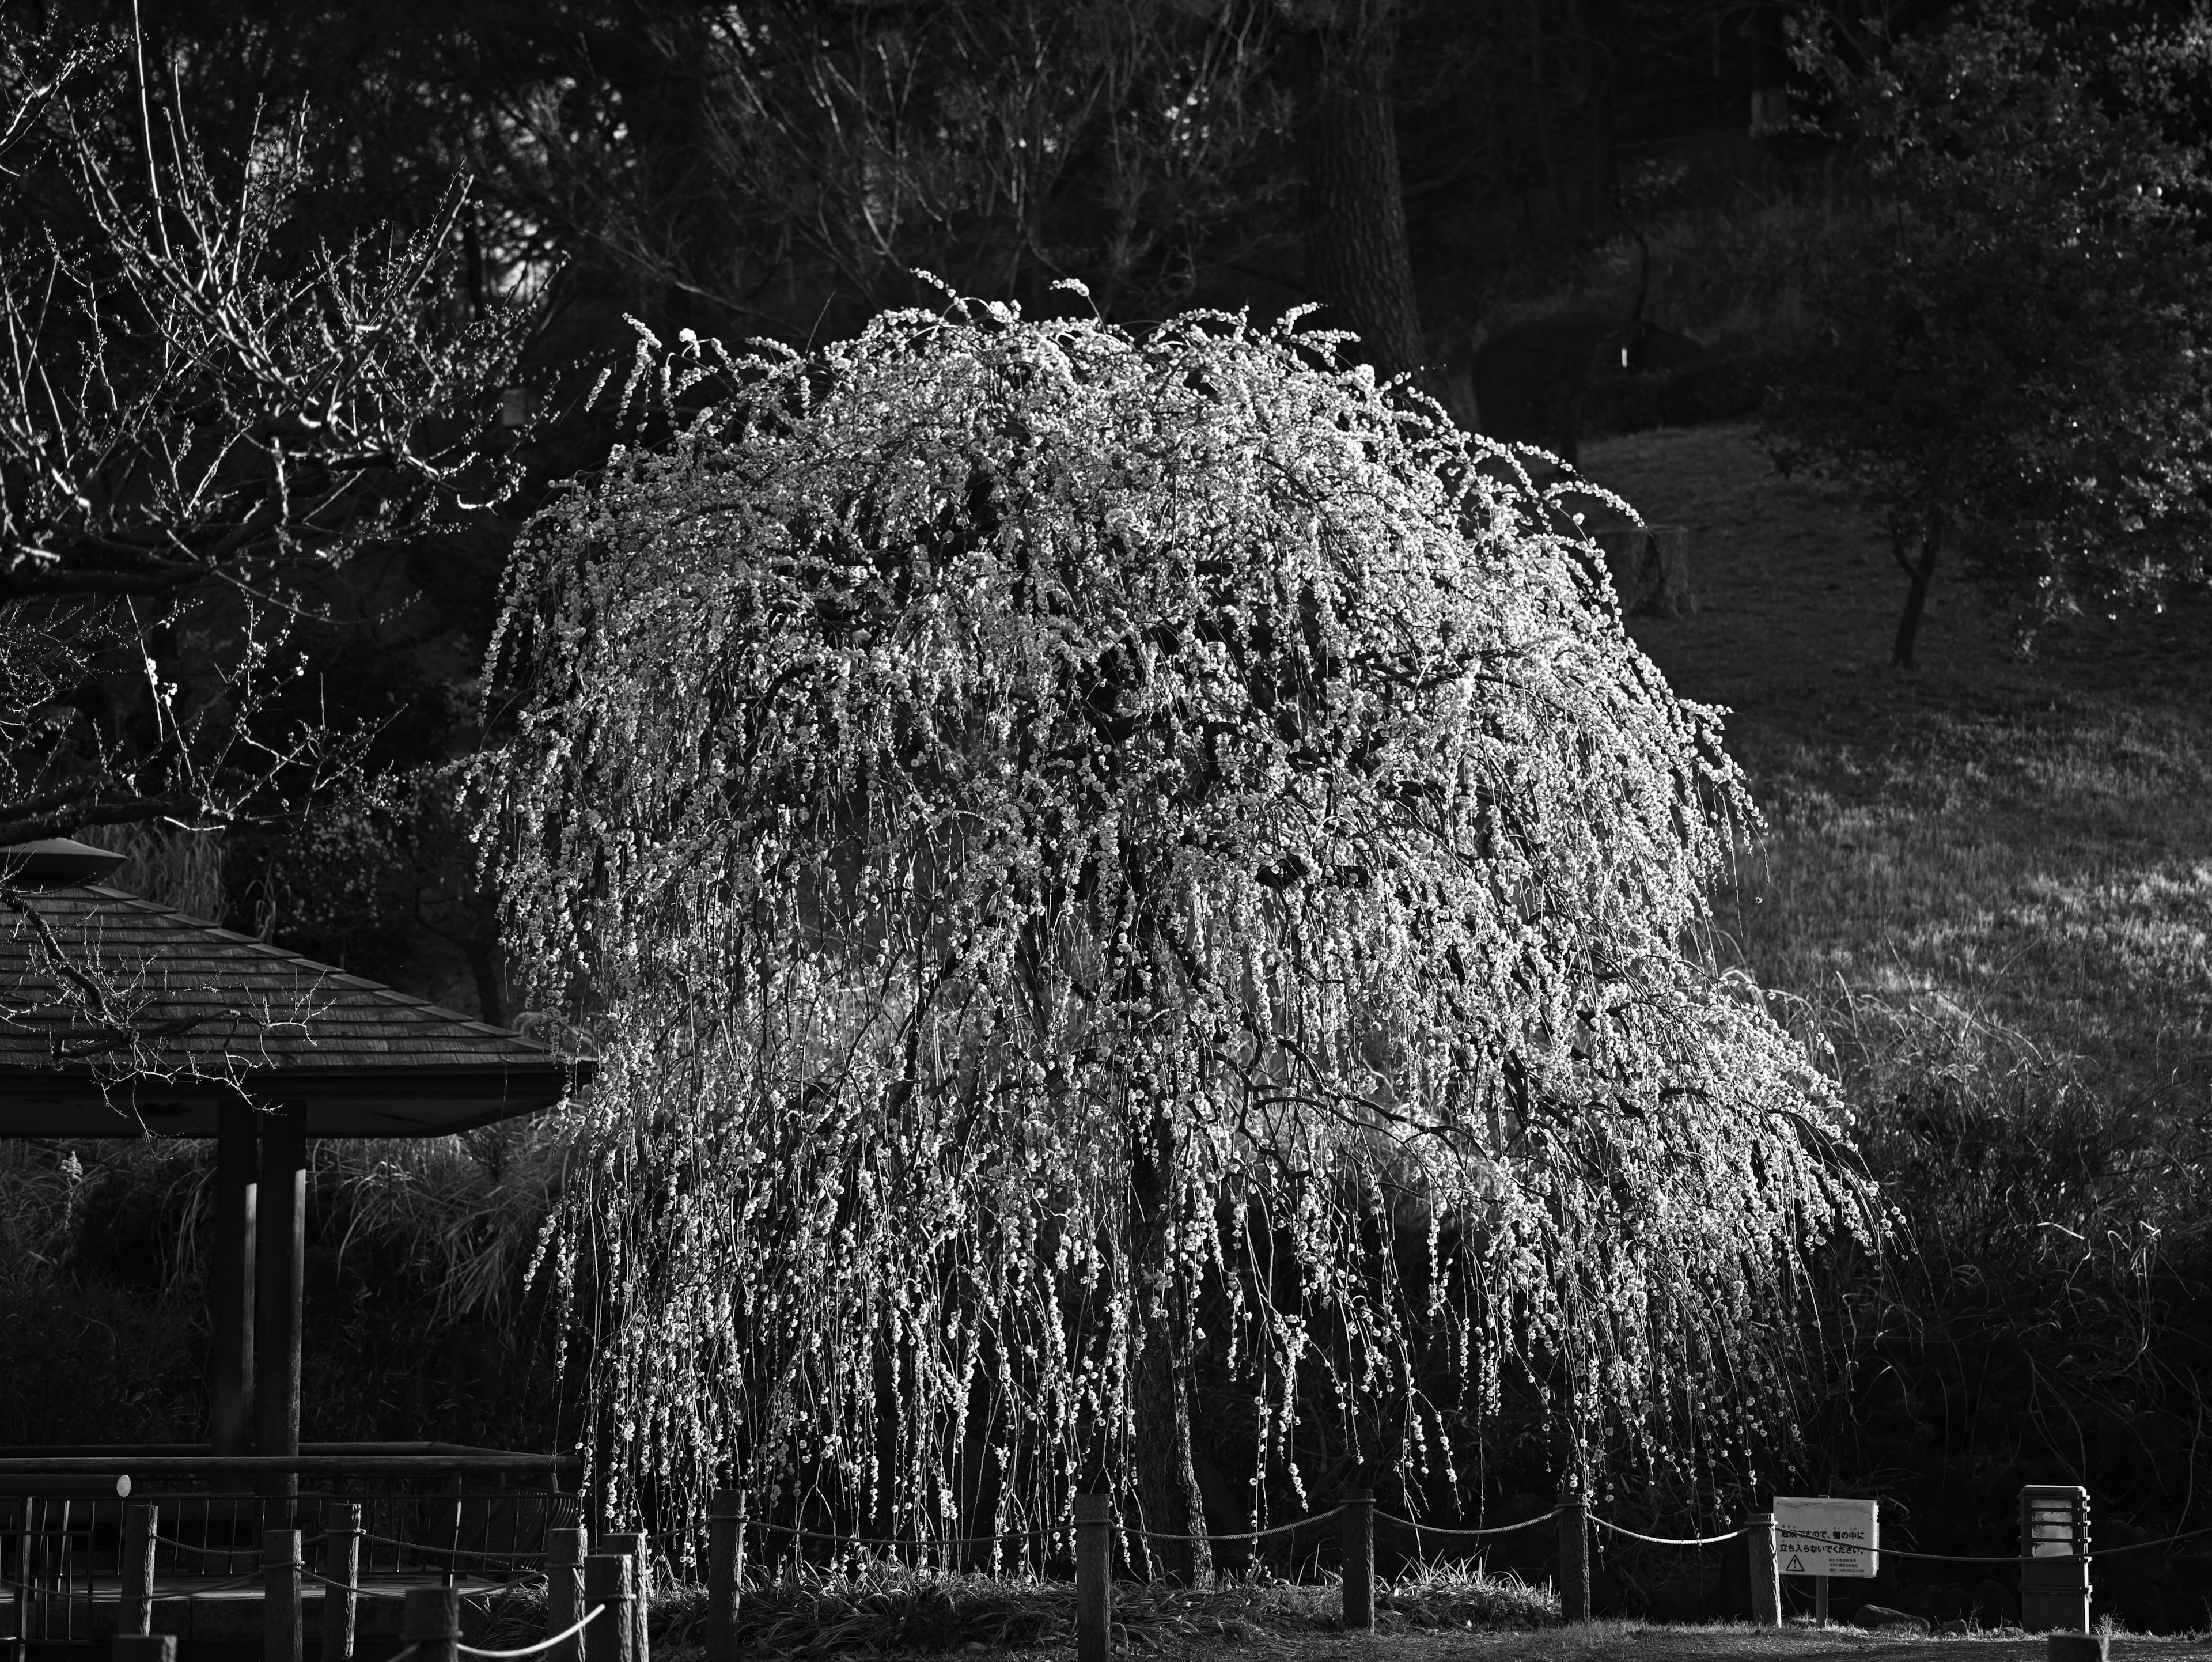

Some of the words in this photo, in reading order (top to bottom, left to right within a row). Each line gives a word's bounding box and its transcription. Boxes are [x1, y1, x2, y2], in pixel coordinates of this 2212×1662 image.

[1779, 1543, 1863, 1554] 立ち入らないでください。
